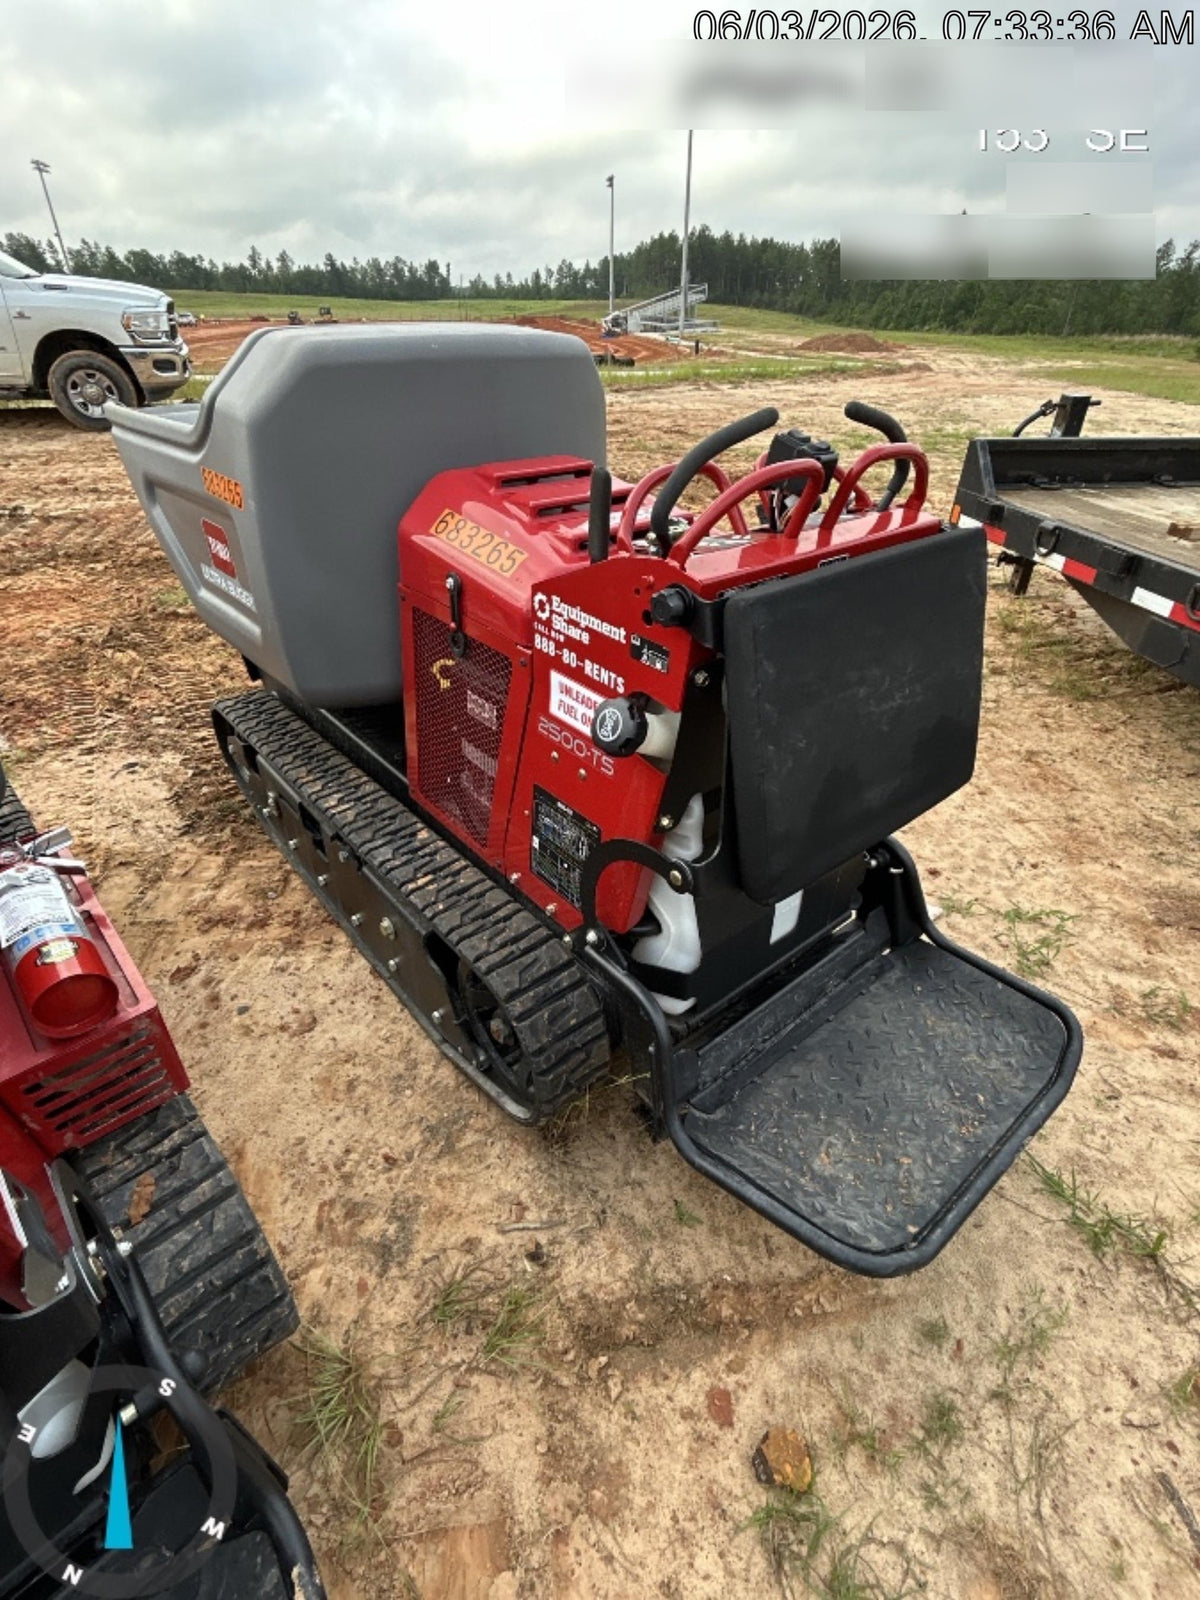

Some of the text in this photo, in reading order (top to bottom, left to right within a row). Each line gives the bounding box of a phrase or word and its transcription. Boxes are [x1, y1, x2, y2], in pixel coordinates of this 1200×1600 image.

[434, 511, 525, 573] 683265
[551, 594, 627, 644] Equipment
[551, 613, 590, 645] Share
[534, 633, 625, 694] 888-80-RENTS
[558, 681, 598, 710] UNLEADE
[558, 699, 579, 722] FUEL
